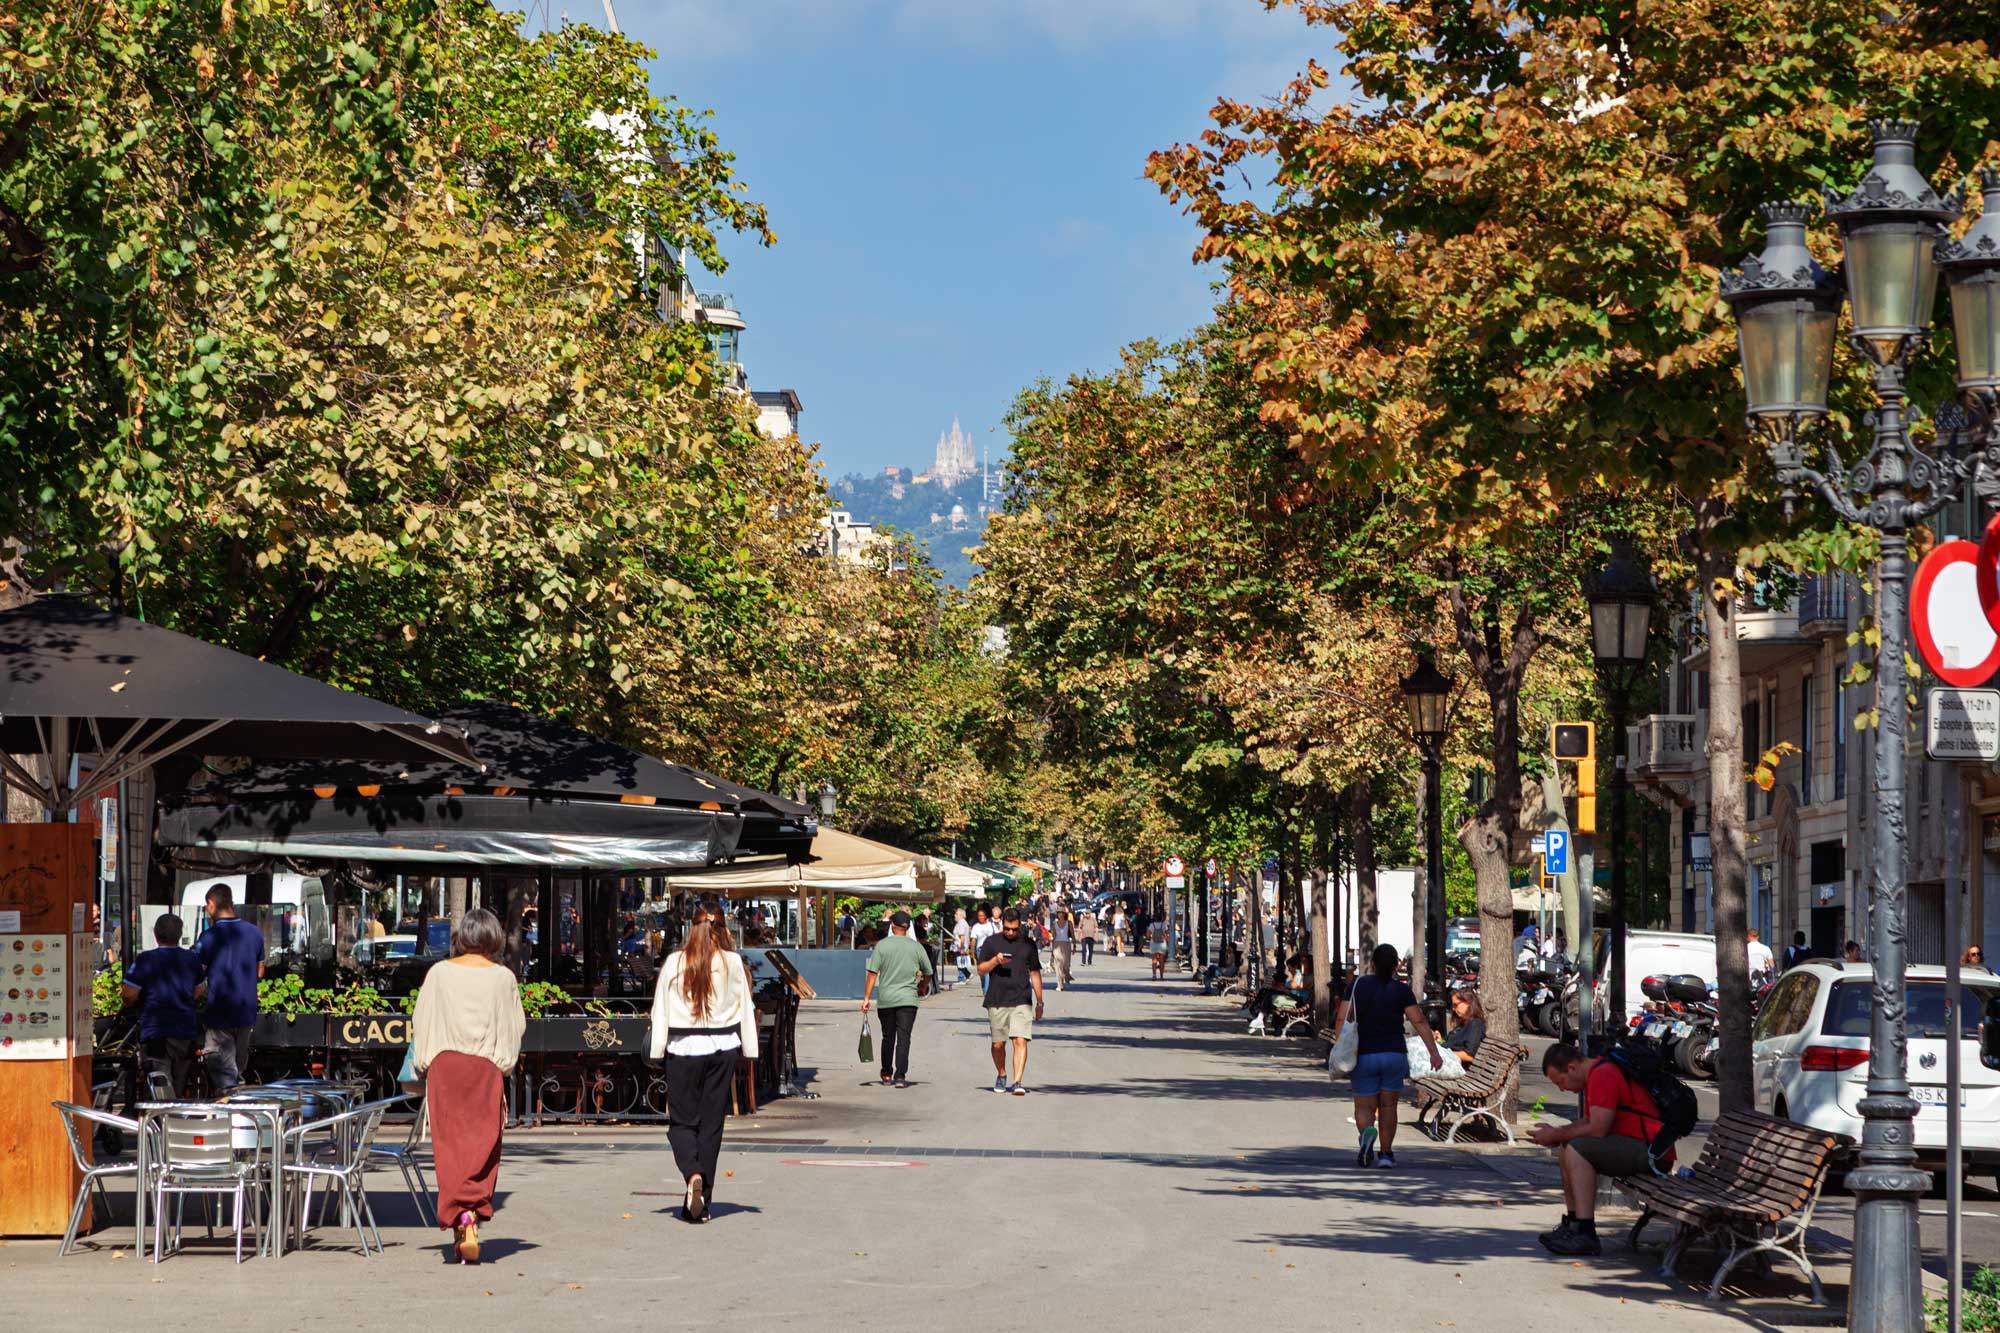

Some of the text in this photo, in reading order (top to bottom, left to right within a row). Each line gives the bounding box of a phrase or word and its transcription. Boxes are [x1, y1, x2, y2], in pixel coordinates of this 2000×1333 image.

[1966, 699, 1985, 711] 11-21
[1986, 699, 1992, 711] h
[1933, 717, 1962, 732] Excepte
[1549, 833, 1564, 857] P
